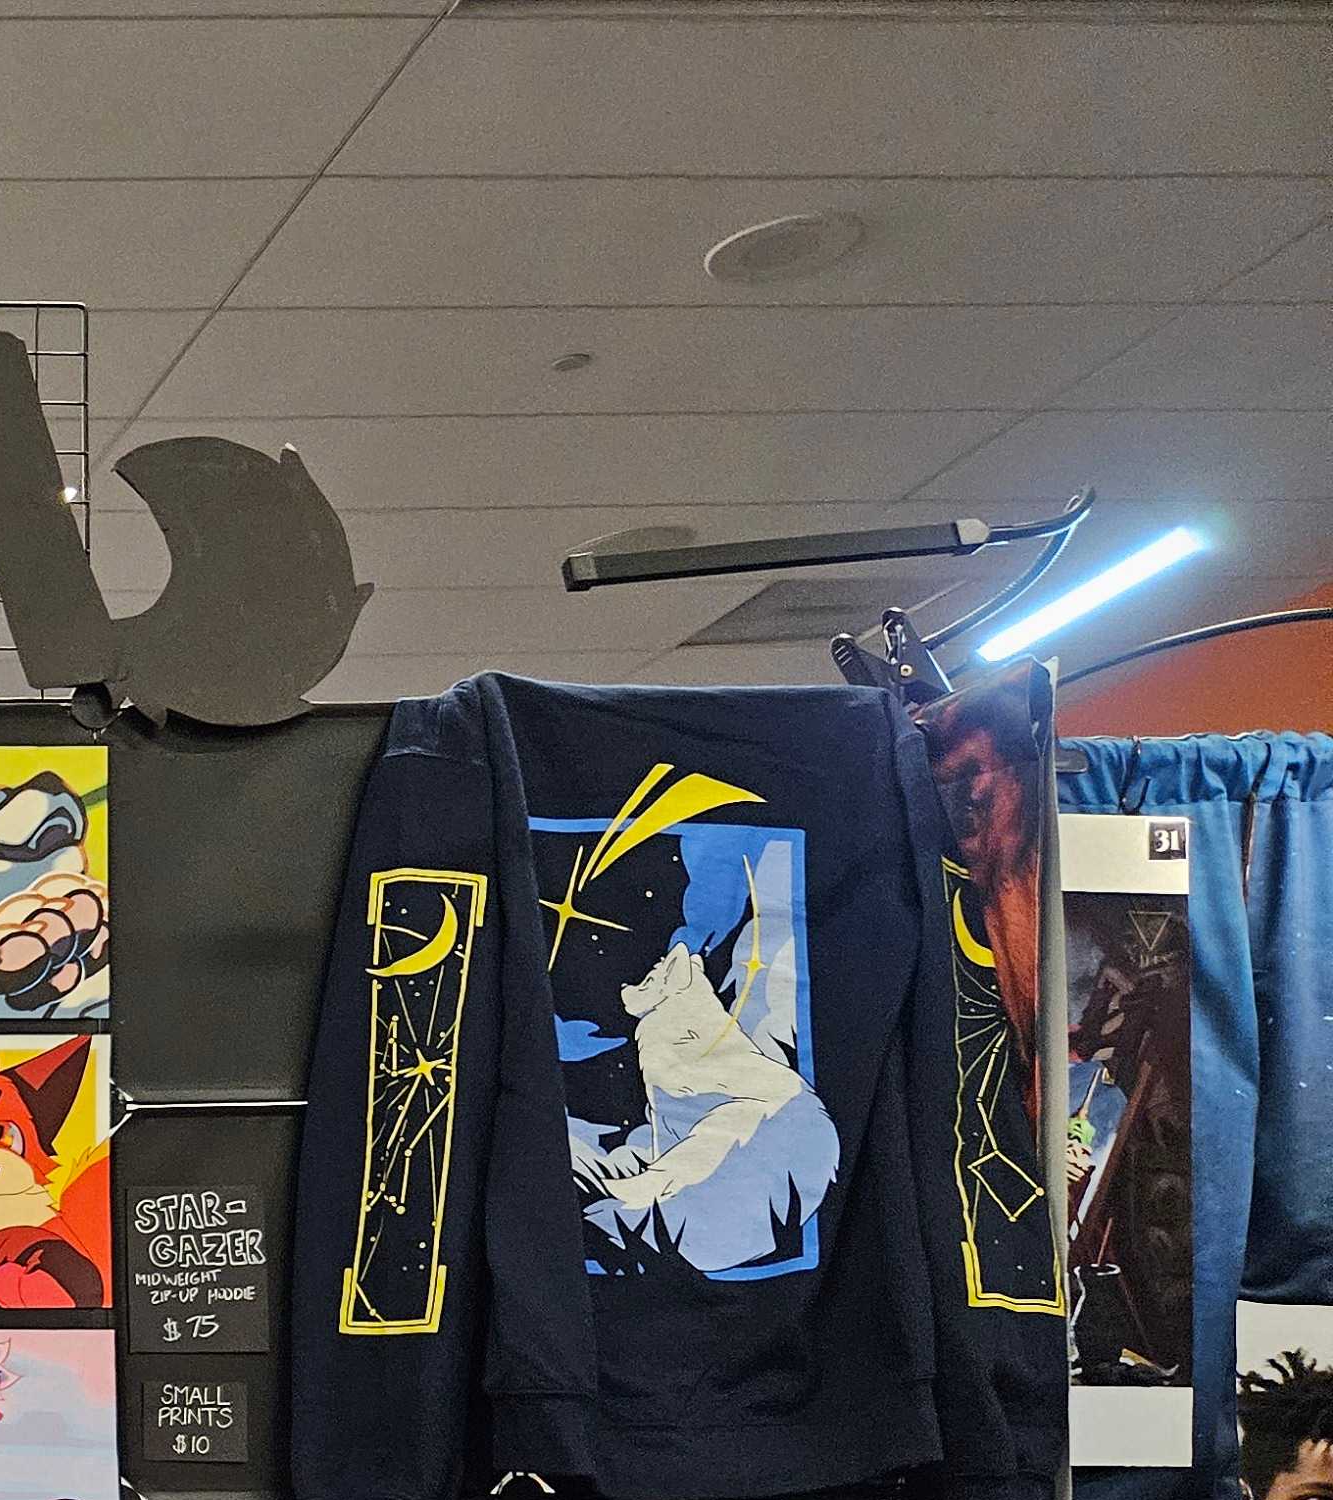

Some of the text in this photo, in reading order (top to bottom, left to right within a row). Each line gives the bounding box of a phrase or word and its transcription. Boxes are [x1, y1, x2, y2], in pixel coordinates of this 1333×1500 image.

[1154, 829, 1181, 853] 31
[134, 1190, 247, 1235] STAR-
[148, 1228, 267, 1269] GAZER
[149, 1285, 256, 1305] ZIP-UP HOODIE
[161, 1383, 232, 1406] SMALL
[158, 1406, 233, 1429] PRINTS
[172, 1434, 211, 1455] $10
